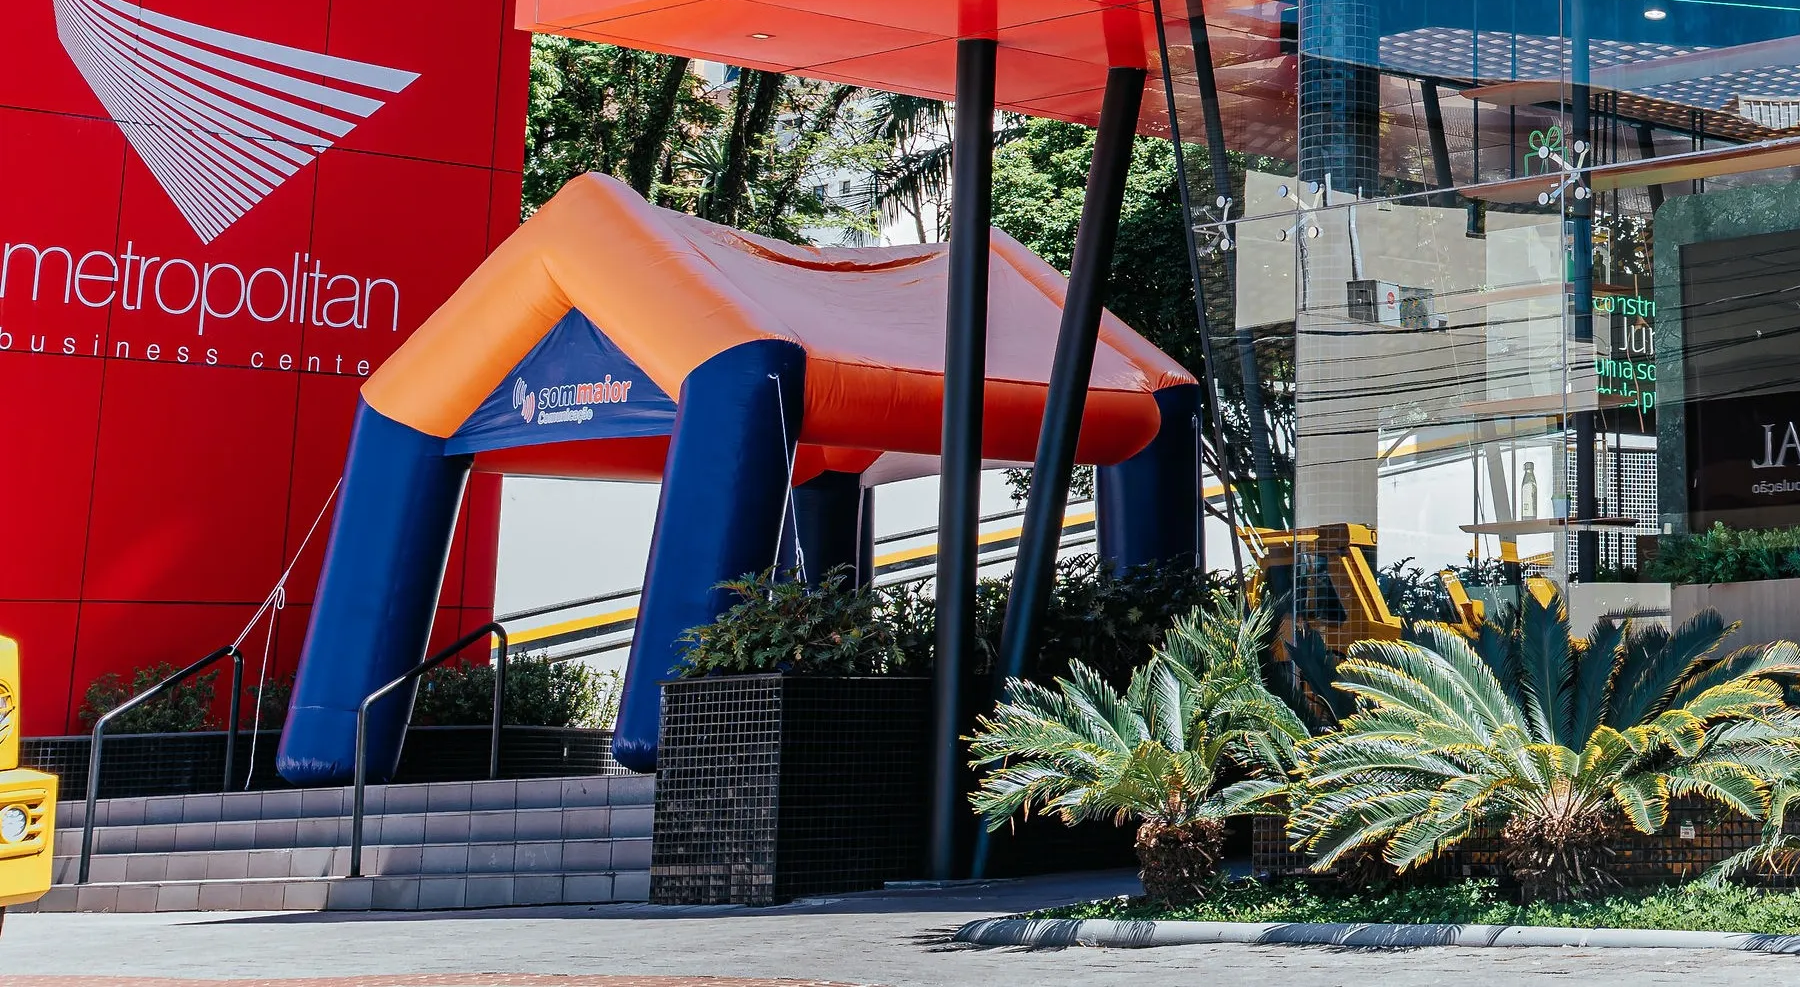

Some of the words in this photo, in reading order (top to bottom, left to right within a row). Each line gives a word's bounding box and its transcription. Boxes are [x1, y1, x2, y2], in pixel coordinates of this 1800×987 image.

[0, 240, 401, 336] metropolitan
[0, 326, 219, 365] business
[250, 349, 371, 377] cente
[537, 373, 632, 411] sommaior
[537, 405, 594, 425] Comunicação
